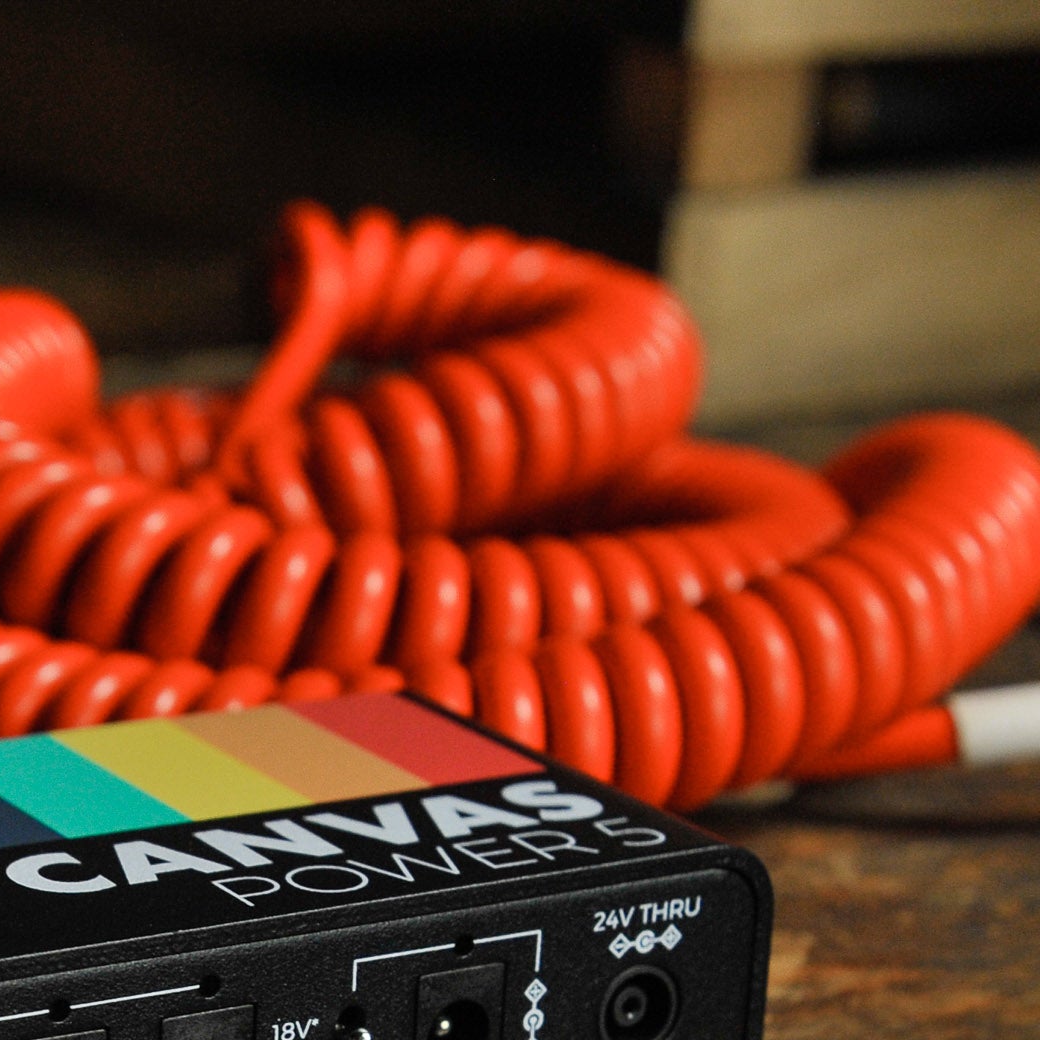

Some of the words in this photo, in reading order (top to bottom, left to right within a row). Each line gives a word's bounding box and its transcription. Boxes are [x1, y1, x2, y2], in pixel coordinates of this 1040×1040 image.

[7, 781, 603, 894] CANVAS
[212, 831, 600, 907] POWER
[594, 817, 667, 847] 5
[593, 908, 637, 933] 24V
[640, 896, 703, 924] THRU
